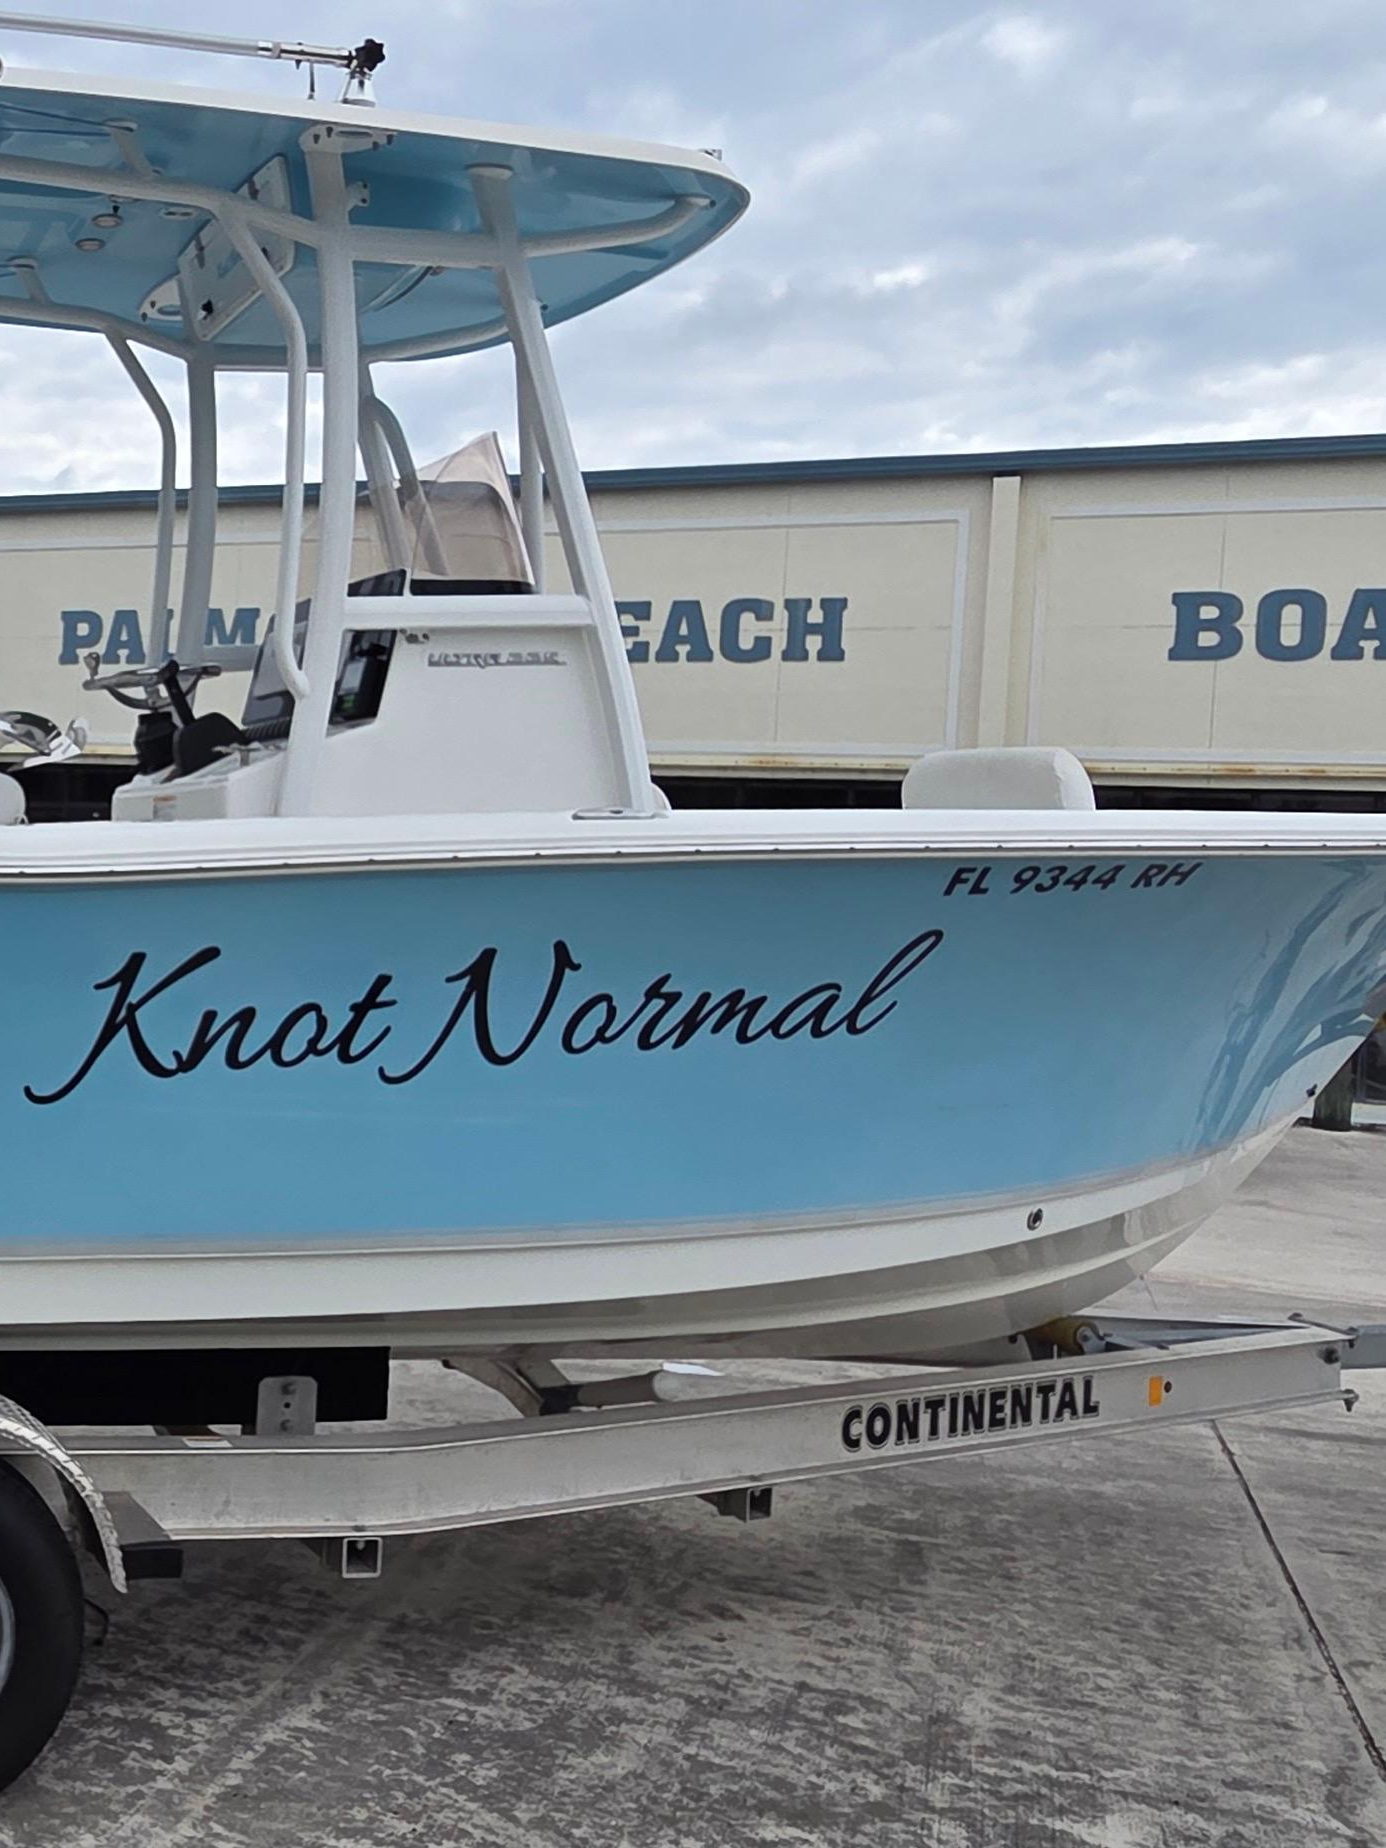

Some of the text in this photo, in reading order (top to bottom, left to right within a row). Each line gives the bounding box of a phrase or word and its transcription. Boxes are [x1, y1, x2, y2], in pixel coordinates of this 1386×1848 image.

[614, 597, 848, 662] EACH
[943, 862, 1204, 896] FL 9344 RH
[23, 928, 944, 1104] Knot Normal
[841, 1375, 1101, 1452] CONTINENTAL
